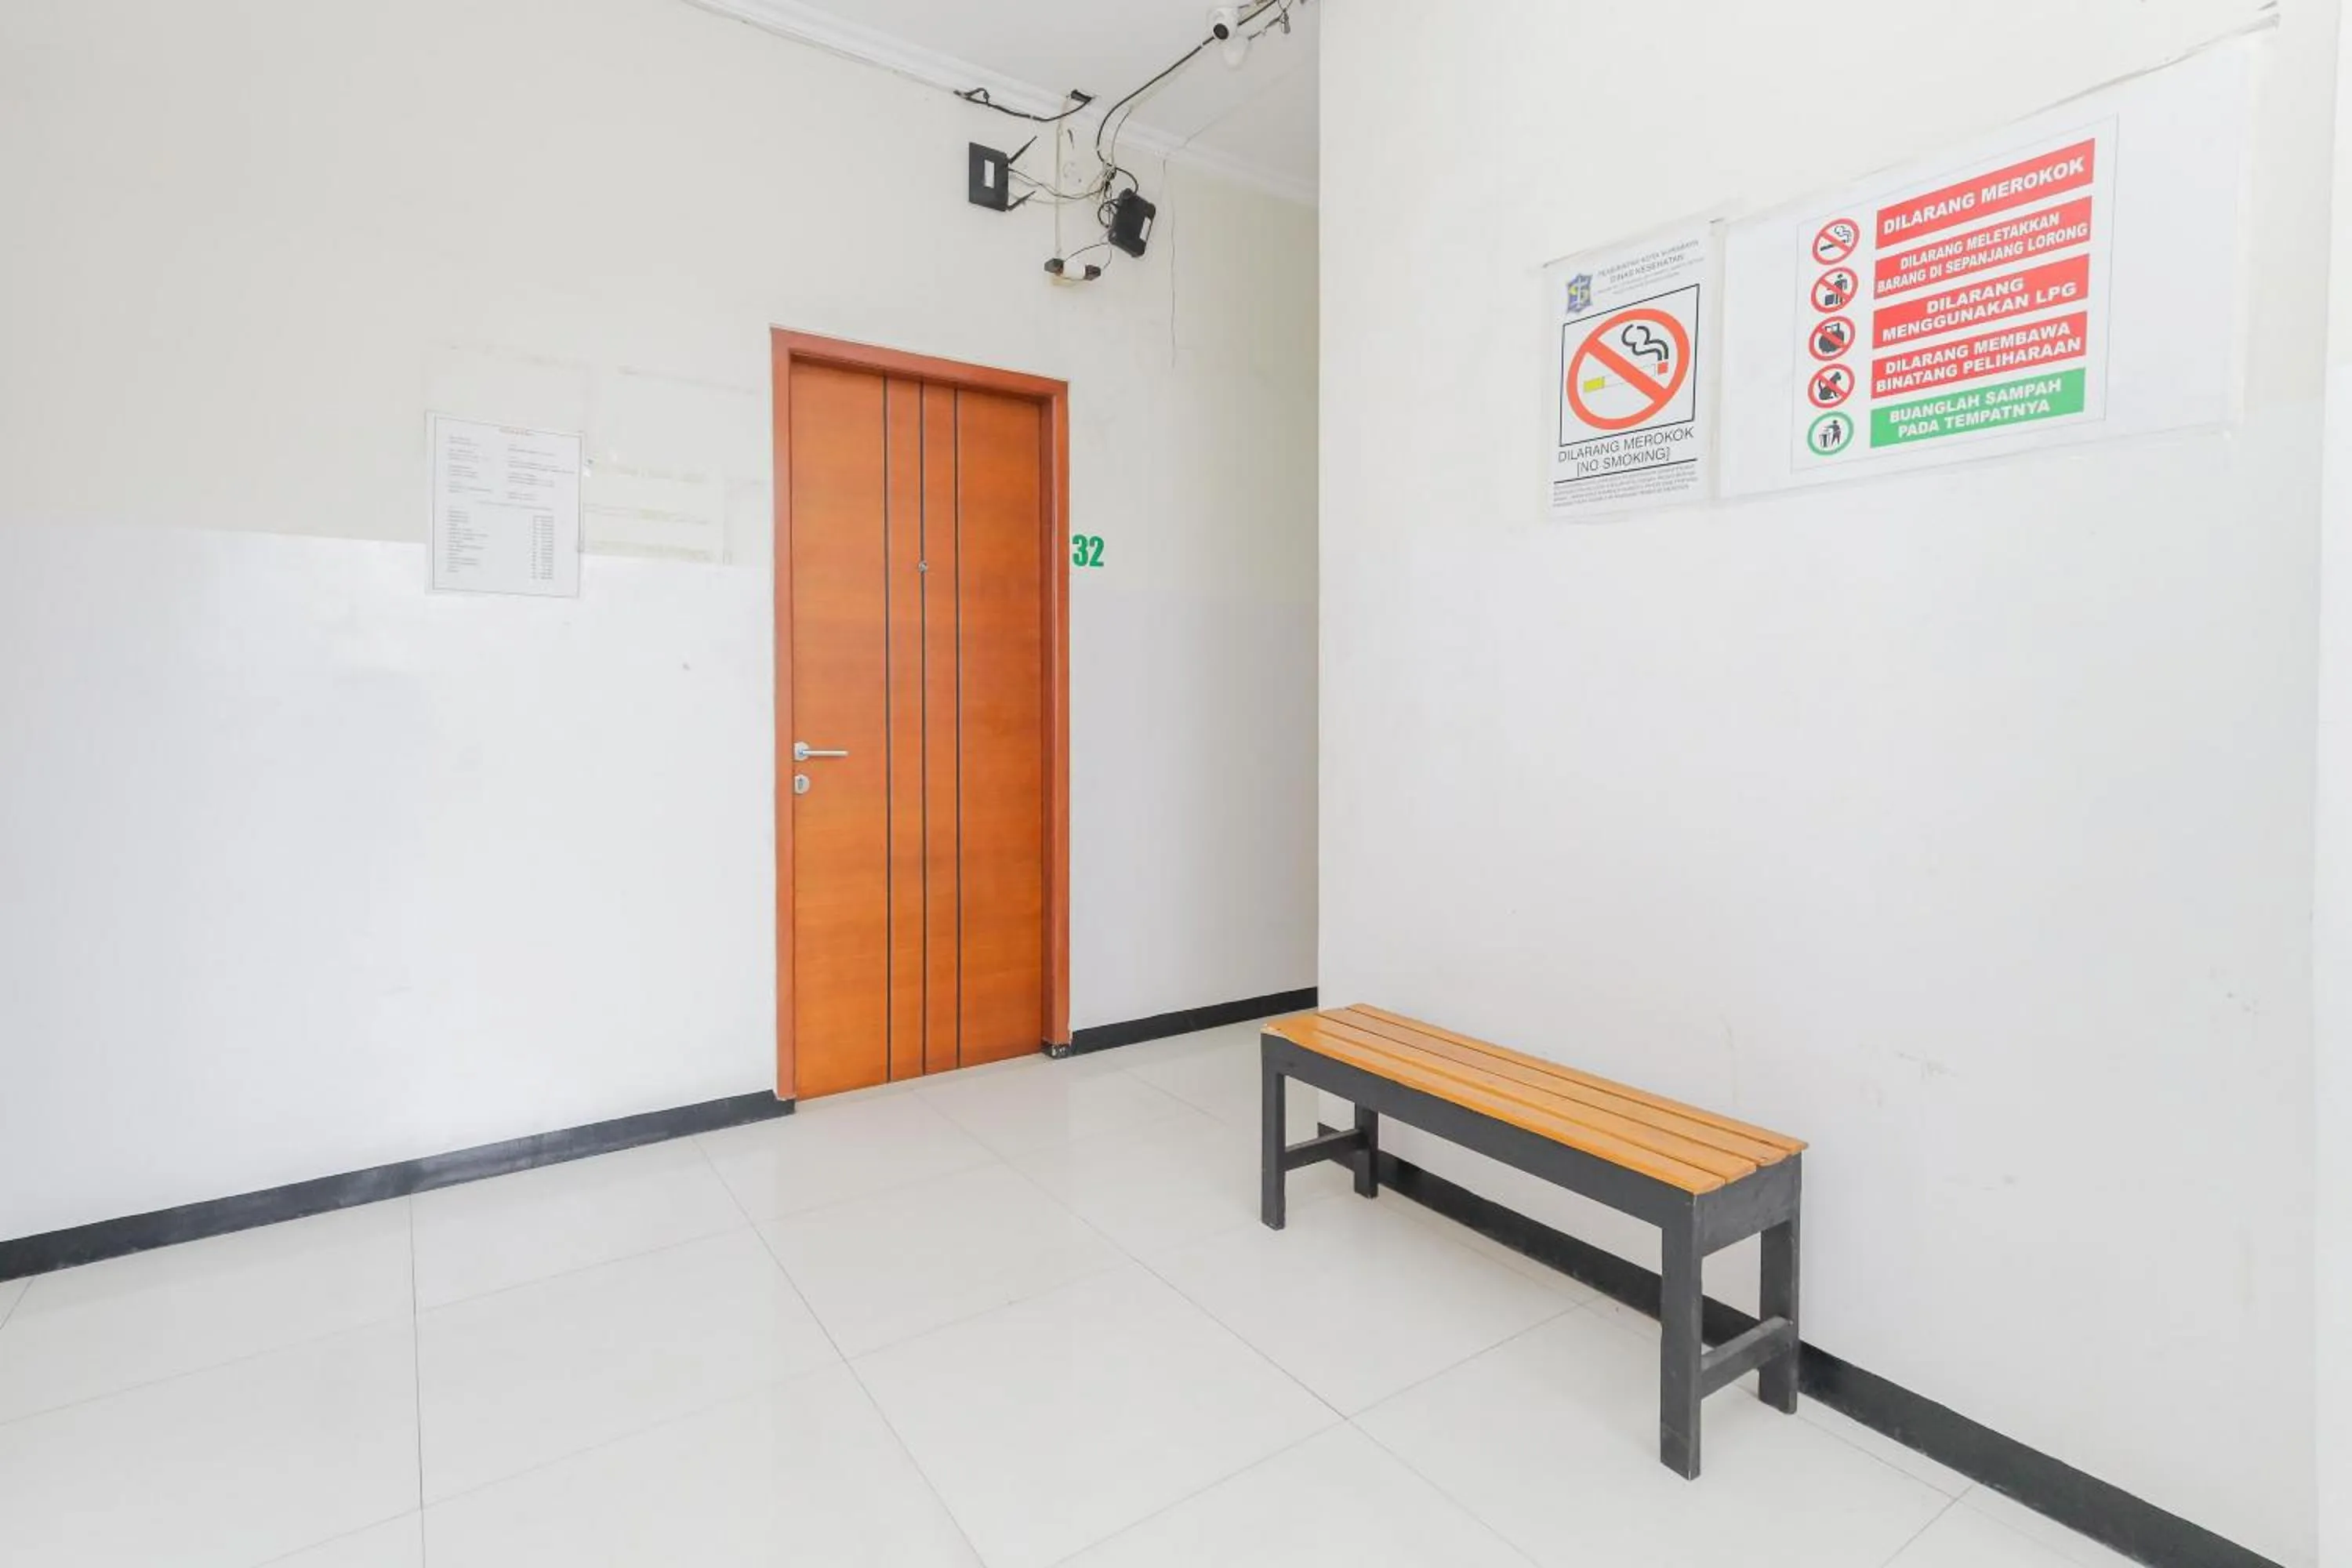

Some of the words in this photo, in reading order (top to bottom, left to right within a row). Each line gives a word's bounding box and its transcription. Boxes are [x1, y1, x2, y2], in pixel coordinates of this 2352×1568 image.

[1884, 192, 1976, 234] DILARANG
[1981, 157, 2085, 204] MEROKOK
[1877, 268, 1926, 293] BARANG
[1929, 264, 1943, 278] DI
[1945, 241, 2024, 274] SEPANJANG
[2027, 222, 2088, 252] LORONG
[1900, 241, 1963, 270] DILARANG
[1967, 212, 2060, 252] MELETAKKAN
[1882, 293, 2029, 342] MENGGUNAKAN
[2036, 281, 2077, 304] LPG
[1926, 277, 2024, 314] DILARANG
[1876, 364, 1958, 392] BINATANG
[1962, 337, 2082, 375] PELIHARAAN
[1885, 344, 1969, 376] DILARANG
[1973, 321, 2071, 355] MEMBAWA
[1889, 394, 1980, 423] BUANGLAH
[1985, 377, 2061, 406] SAMPAH
[1897, 419, 1940, 438] PADA
[1944, 398, 2051, 430] TEMPATNYA
[1558, 441, 1620, 463] DILARANG
[1624, 426, 1694, 451] MEROKOK
[1577, 459, 1599, 477] [NO
[1602, 446, 1671, 470] SMOKING]
[1072, 534, 1105, 567] 32
